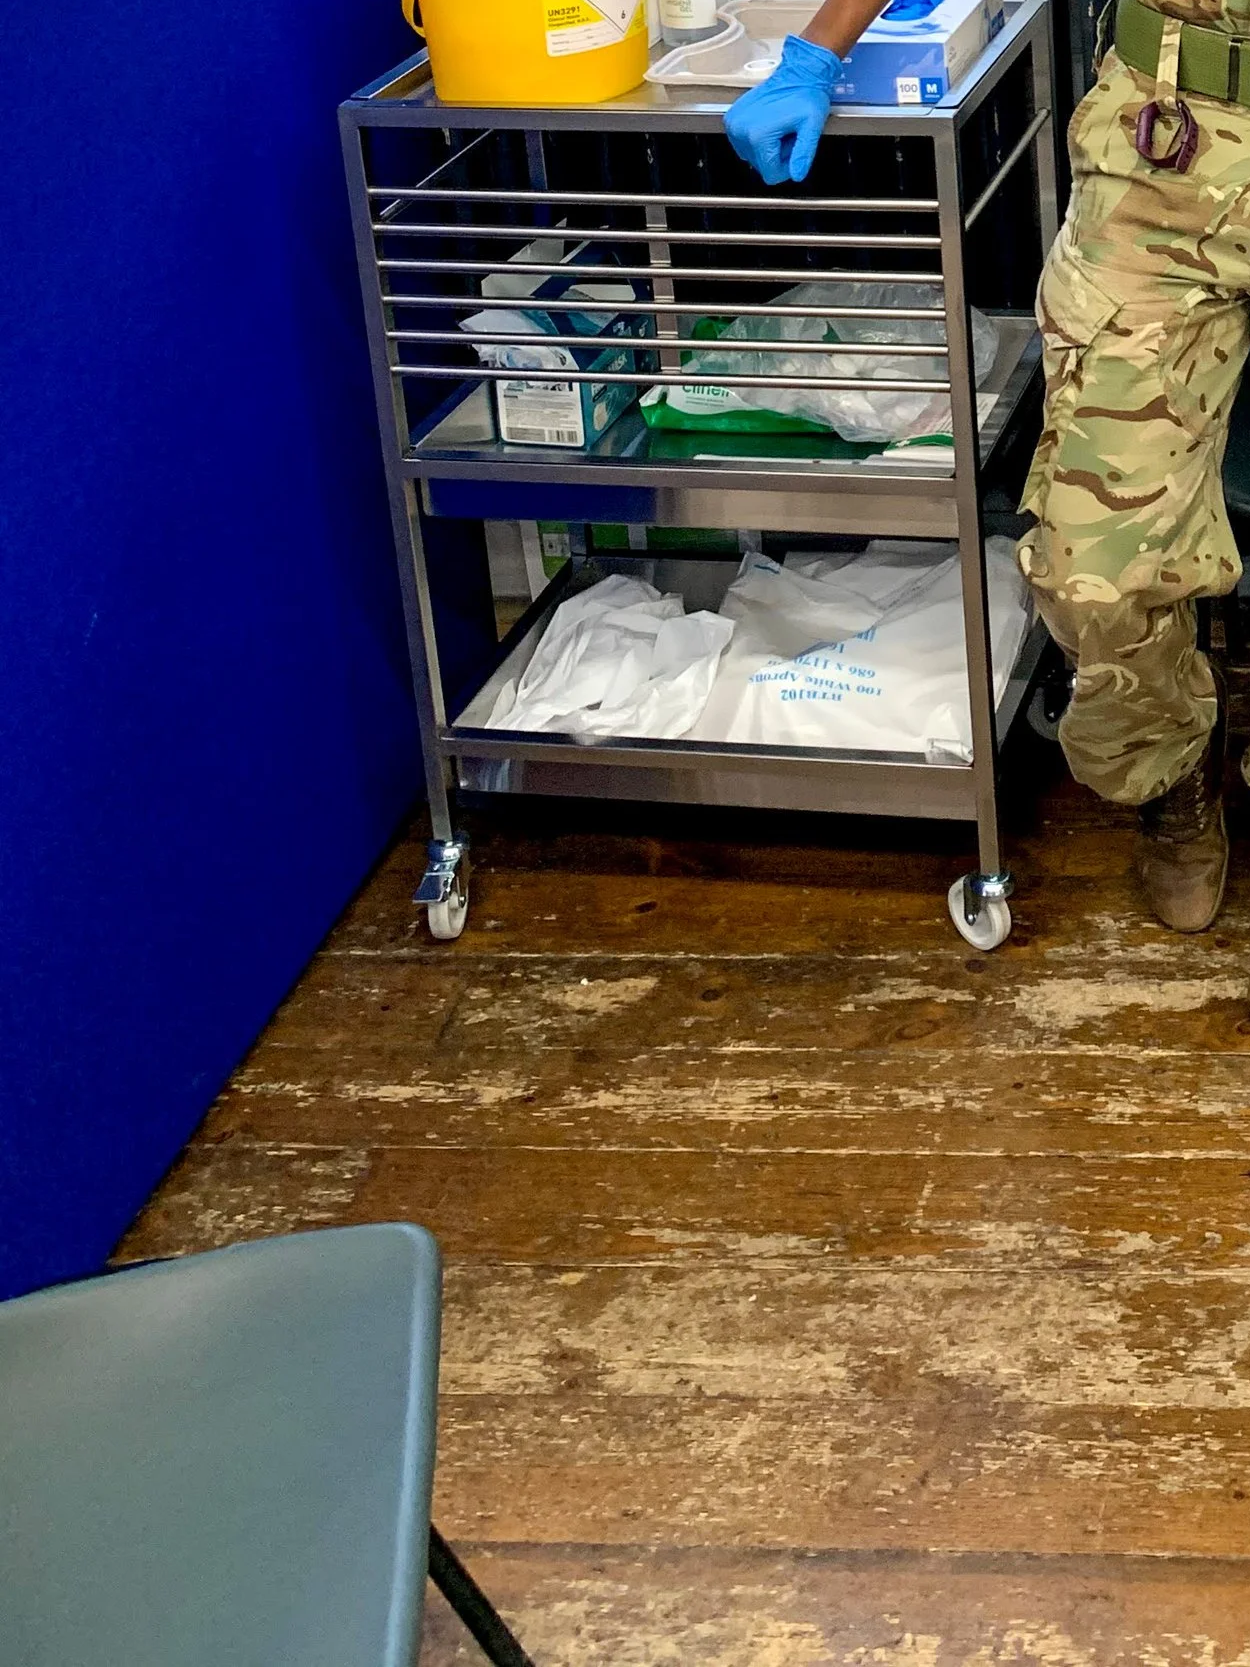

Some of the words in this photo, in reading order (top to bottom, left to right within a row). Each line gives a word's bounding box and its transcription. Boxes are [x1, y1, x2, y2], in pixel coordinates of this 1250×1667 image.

[547, 6, 580, 17] UN3291
[621, 10, 626, 19] 6
[900, 84, 918, 93] 100
[926, 83, 938, 93] M
[748, 670, 800, 682] Aprons
[848, 666, 876, 678] 686
[804, 676, 851, 691] White
[856, 684, 882, 696] 100
